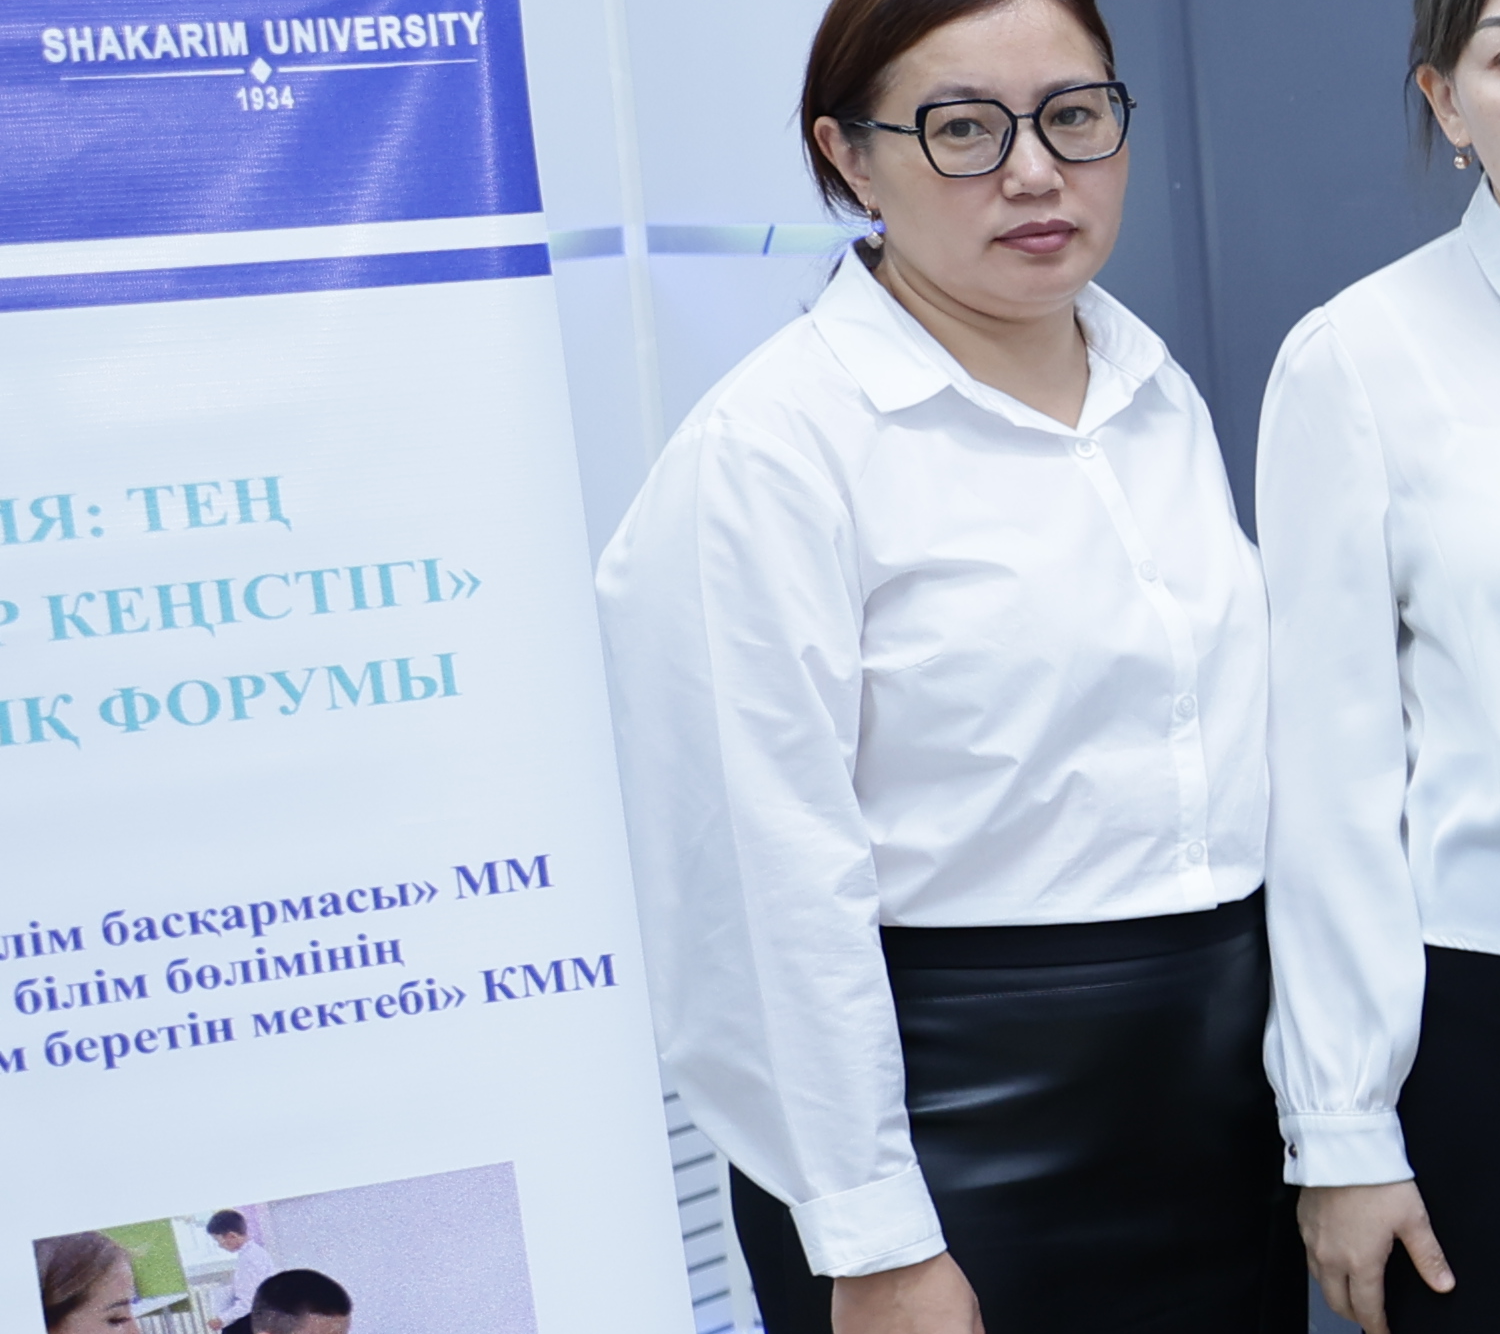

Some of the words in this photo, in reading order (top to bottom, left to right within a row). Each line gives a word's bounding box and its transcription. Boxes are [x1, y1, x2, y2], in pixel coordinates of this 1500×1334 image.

[41, 19, 248, 66] SHAKARIM
[264, 9, 485, 57] UNIVERSITY
[235, 84, 296, 114] 1934
[127, 476, 293, 535] ТЕҢ
[48, 556, 482, 645] КЕҢІСТІГІ»
[98, 651, 463, 735] ФОРУМЫ
[101, 872, 440, 950] басқармасы»
[453, 853, 553, 903] ММ
[14, 968, 150, 1017] білім
[164, 931, 405, 998] бөлімінің
[43, 994, 240, 1071] беретін
[251, 981, 468, 1041] мектебі»
[482, 952, 618, 1005] КММ
